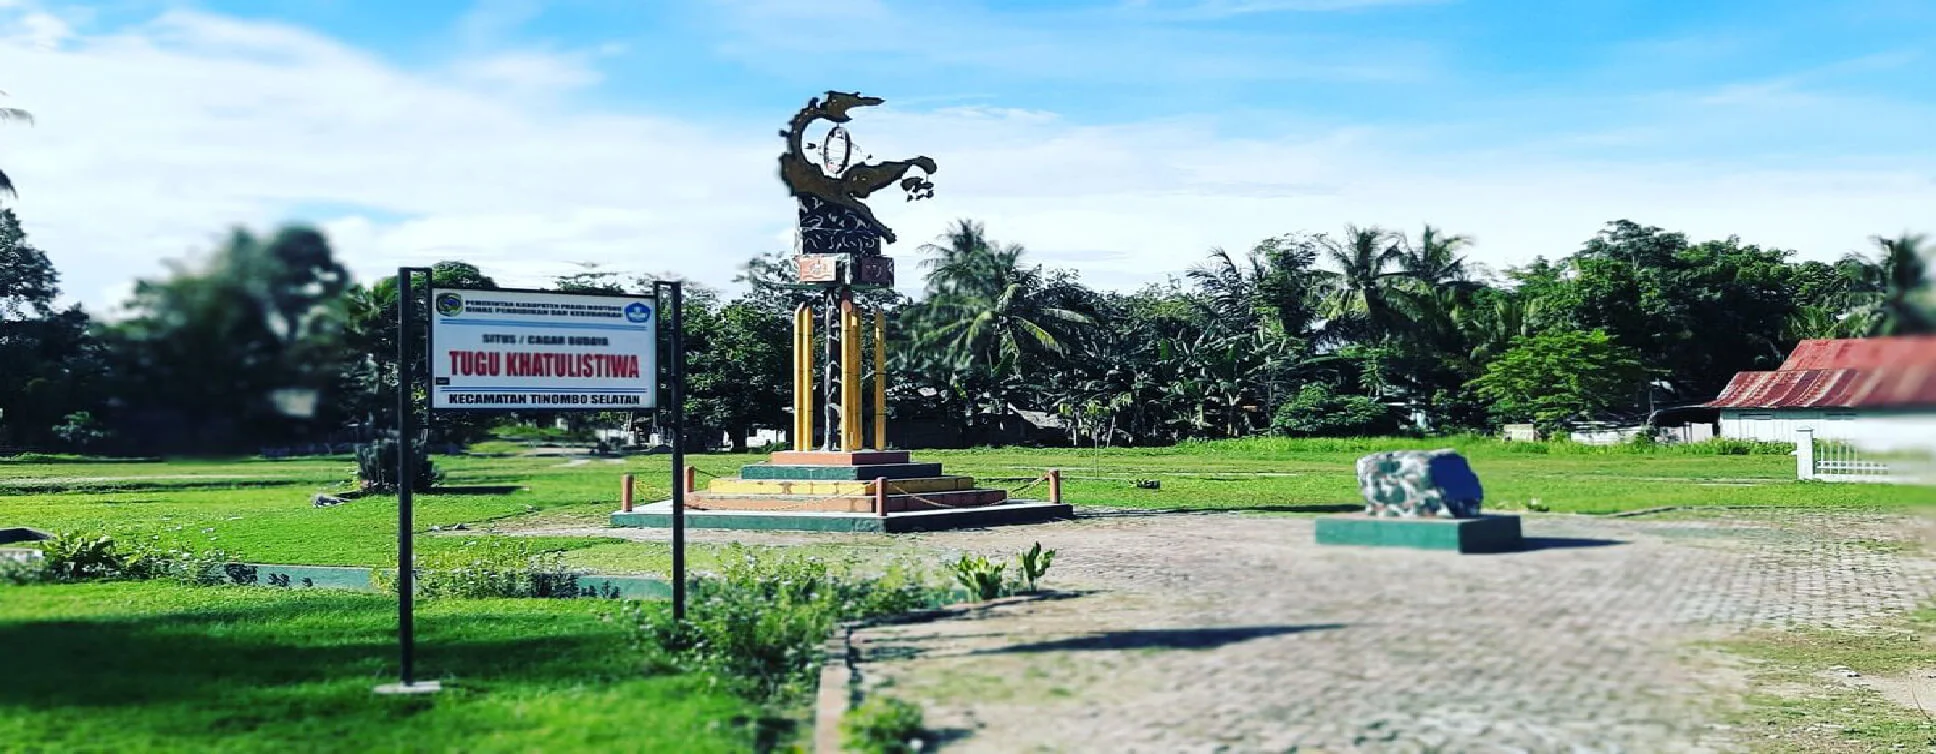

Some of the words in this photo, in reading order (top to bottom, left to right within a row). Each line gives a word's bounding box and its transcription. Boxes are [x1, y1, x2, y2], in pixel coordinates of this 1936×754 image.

[482, 334, 516, 343] SITUS
[449, 351, 500, 376] TUGU
[506, 352, 640, 378] KHATULISTIWA
[449, 394, 527, 404] KECAMATAN
[531, 394, 588, 404] TINOMBO
[591, 394, 640, 405] SELATAN
